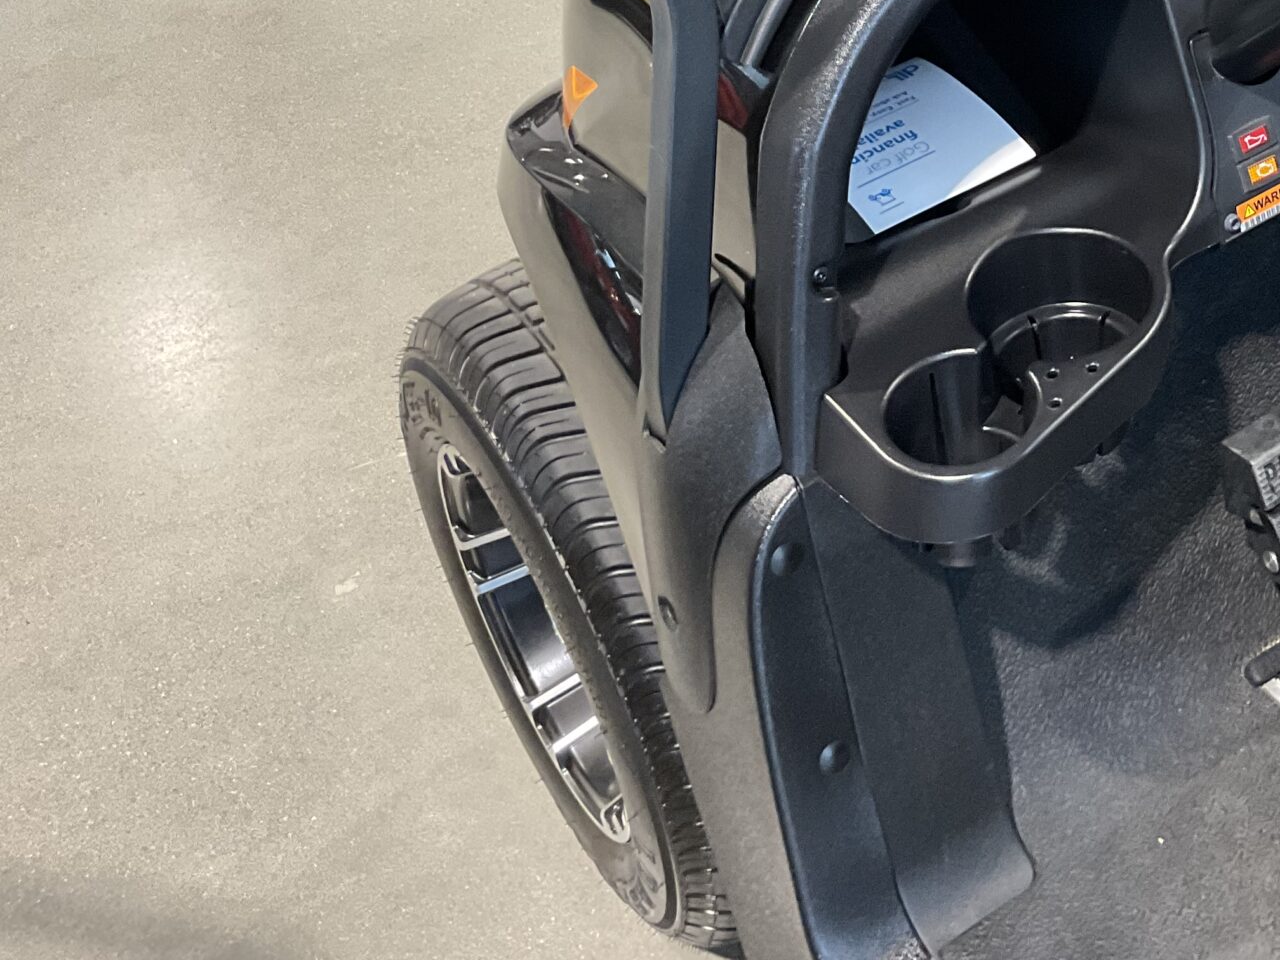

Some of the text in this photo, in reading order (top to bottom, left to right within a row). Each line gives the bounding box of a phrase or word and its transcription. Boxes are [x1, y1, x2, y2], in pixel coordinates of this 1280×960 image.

[851, 130, 918, 165] financin
[857, 120, 905, 146] availa
[866, 141, 930, 175] Golf car
